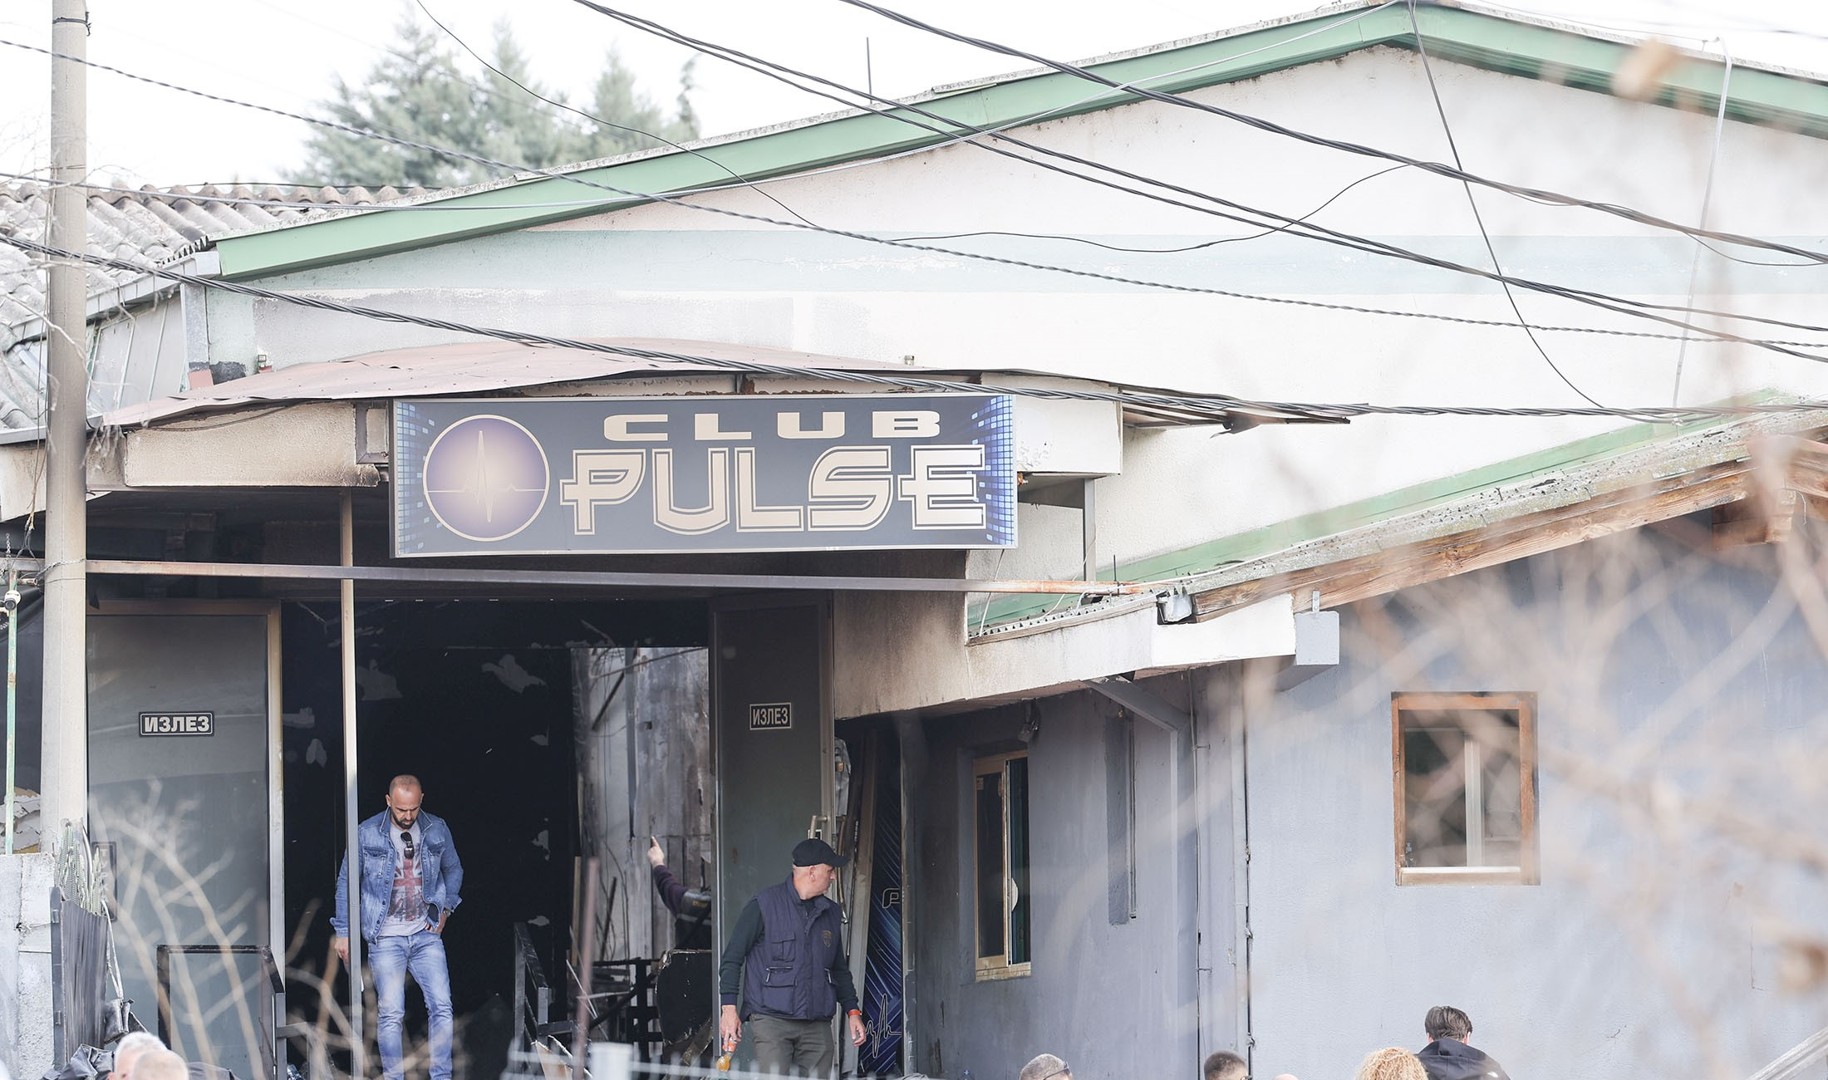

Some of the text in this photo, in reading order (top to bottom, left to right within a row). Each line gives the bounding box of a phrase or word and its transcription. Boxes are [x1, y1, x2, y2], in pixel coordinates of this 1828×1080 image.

[603, 410, 941, 441] CLUB
[559, 444, 987, 536] PULSE
[144, 716, 210, 733] ИЗЛЕЗ
[752, 707, 789, 725] ИЗЛЕЗ
